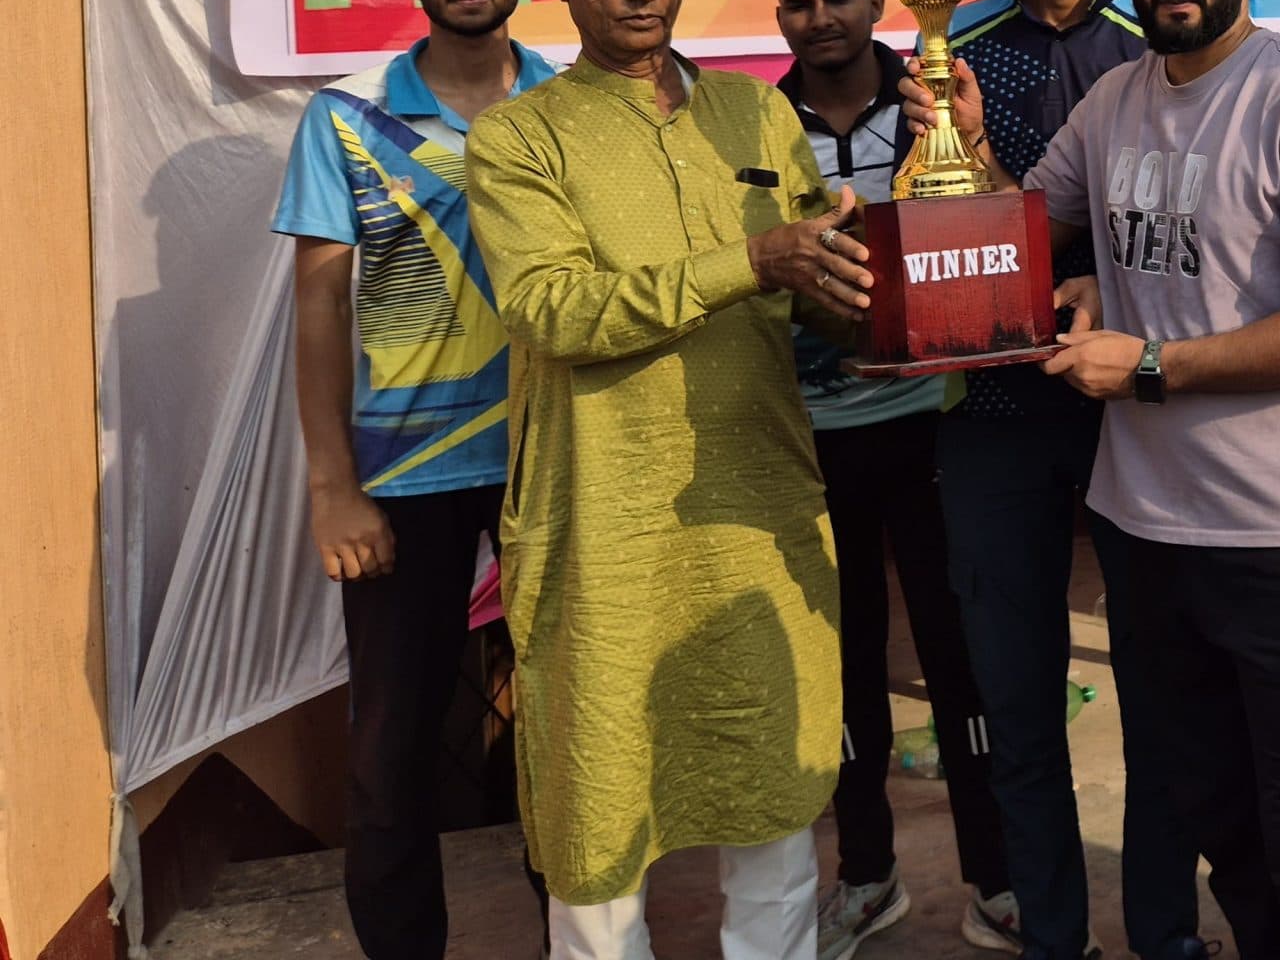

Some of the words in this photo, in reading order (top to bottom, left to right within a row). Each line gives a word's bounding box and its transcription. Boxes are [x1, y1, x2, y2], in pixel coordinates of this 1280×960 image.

[1108, 147, 1208, 214] BOLD
[904, 243, 1021, 284] WINNER
[1109, 205, 1200, 279] STEPS
